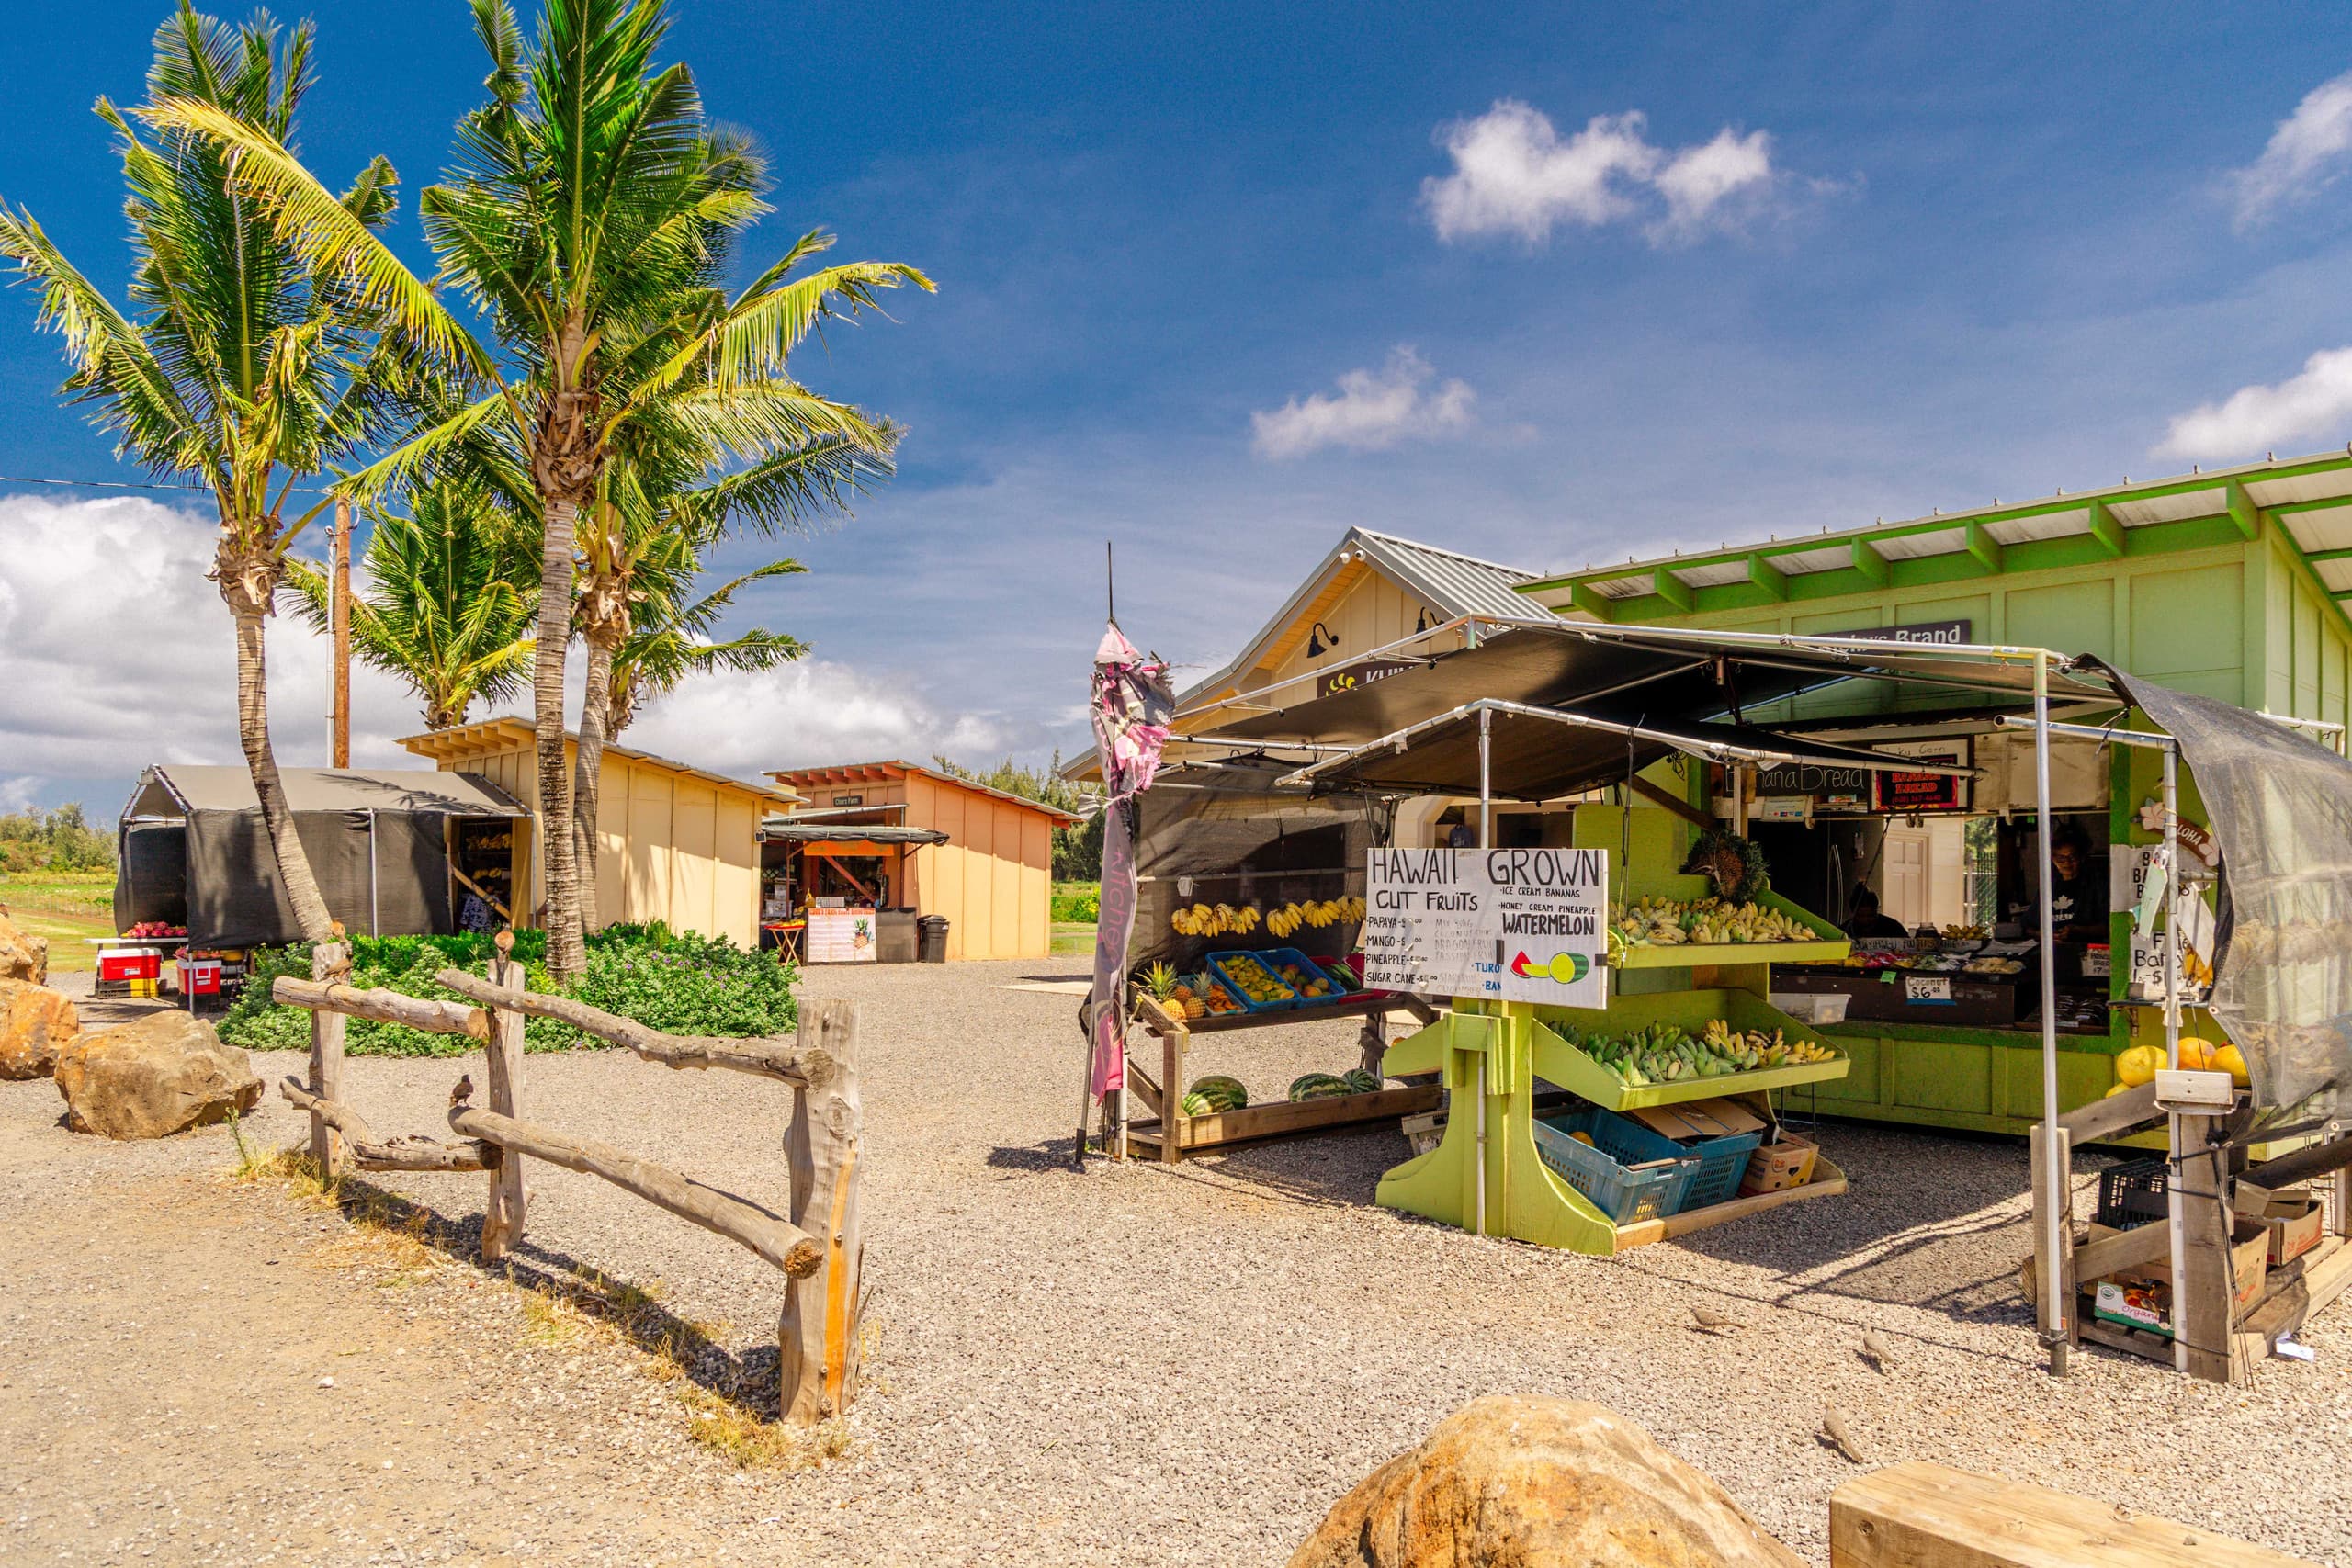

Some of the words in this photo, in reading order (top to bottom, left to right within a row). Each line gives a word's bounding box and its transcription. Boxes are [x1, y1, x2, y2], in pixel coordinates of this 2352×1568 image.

[1895, 624, 1961, 643] Brand
[1725, 765, 1798, 792] nana
[2177, 824, 2203, 845] LOHA
[1372, 848, 1457, 884] HAWAII
[1487, 849, 1600, 886] GROWN
[1375, 889, 1418, 909] CUT
[1502, 886, 1514, 895] ICE
[1518, 886, 1541, 896] CREAM
[1545, 888, 1580, 897] BANANAS
[1500, 902, 1523, 910] HONEY
[1529, 903, 1553, 912] CREAM
[1558, 905, 1596, 915] PINEAPPLE
[1502, 912, 1595, 935] WATERMELON
[1365, 971, 1392, 983] SUGAR
[1908, 976, 1948, 987] Coconut
